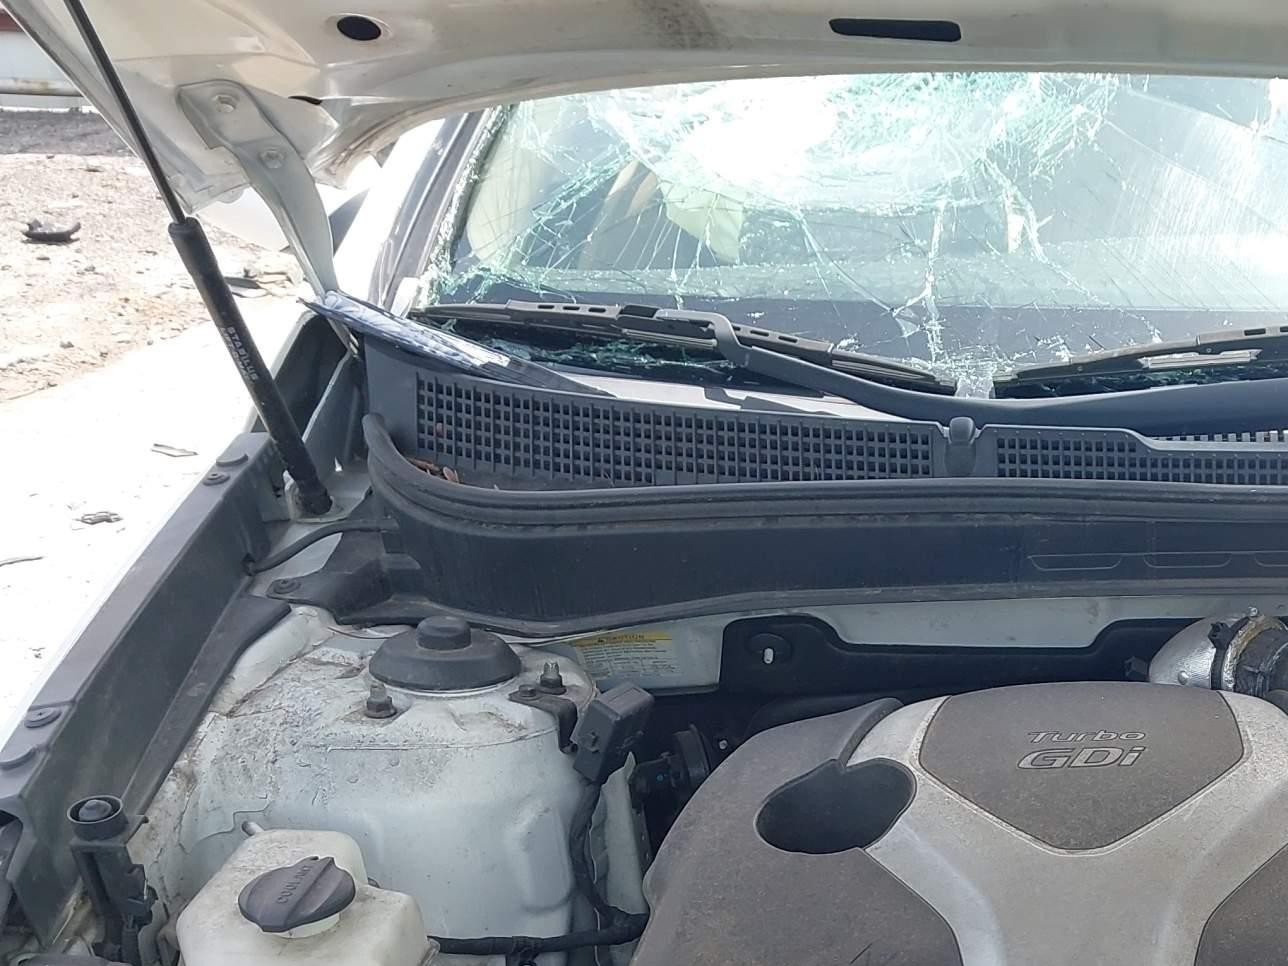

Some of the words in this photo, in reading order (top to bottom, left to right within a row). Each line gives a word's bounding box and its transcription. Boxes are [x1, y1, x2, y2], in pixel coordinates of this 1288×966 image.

[226, 326, 260, 380] STABILUS
[1028, 730, 1147, 744] Turbo
[1017, 746, 1148, 769] GDi
